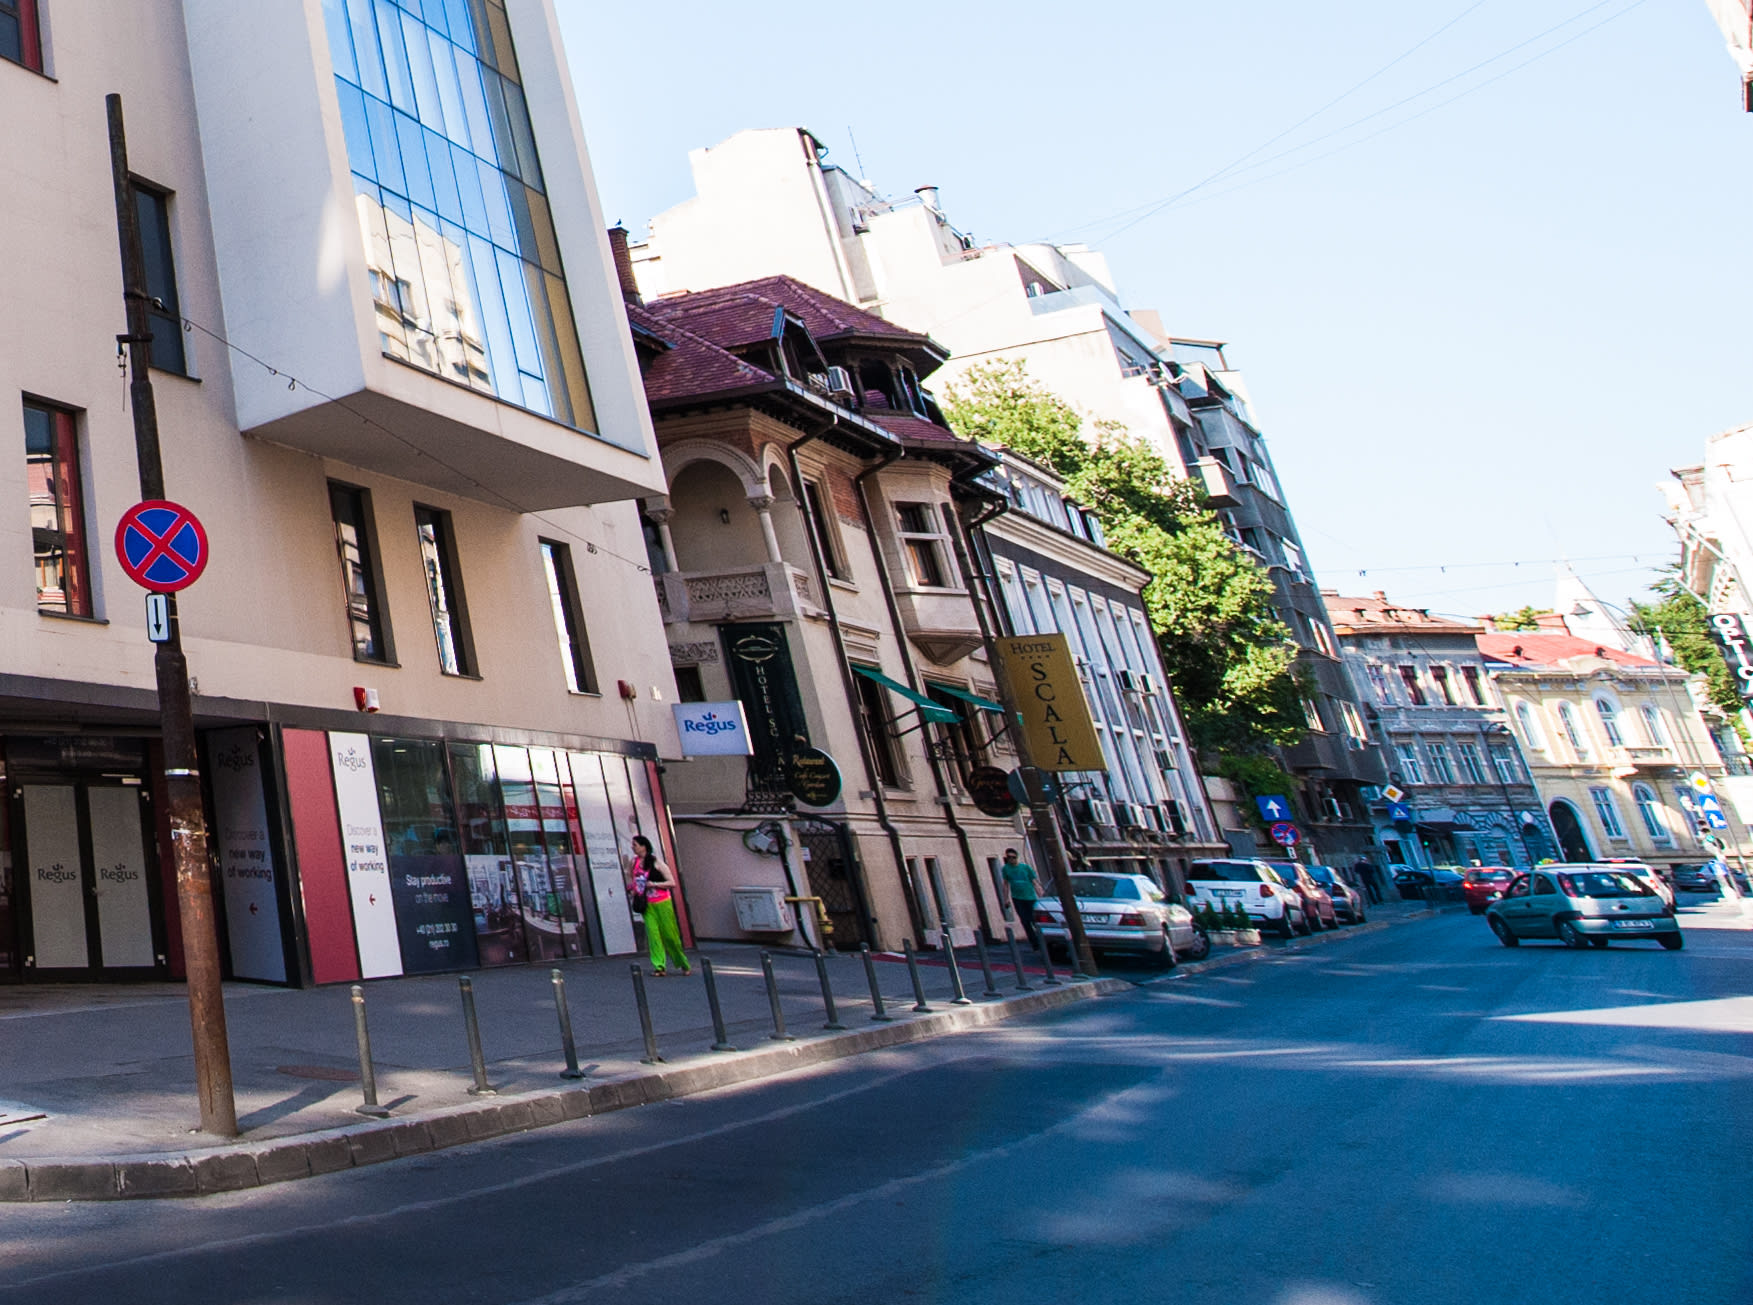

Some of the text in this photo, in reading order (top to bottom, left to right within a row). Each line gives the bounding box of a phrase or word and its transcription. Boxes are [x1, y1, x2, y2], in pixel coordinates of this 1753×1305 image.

[1010, 642, 1056, 655] HOTEL
[1712, 614, 1753, 696] OPTIC
[1030, 662, 1077, 765] SCALA
[684, 718, 736, 735] Regus
[218, 752, 254, 772] Regus
[337, 752, 367, 772] Regus
[229, 849, 265, 862] new way
[350, 844, 379, 856] new way
[227, 866, 273, 882] of working
[350, 859, 385, 874] of working
[37, 868, 77, 883] Regus
[100, 868, 139, 883] Regus
